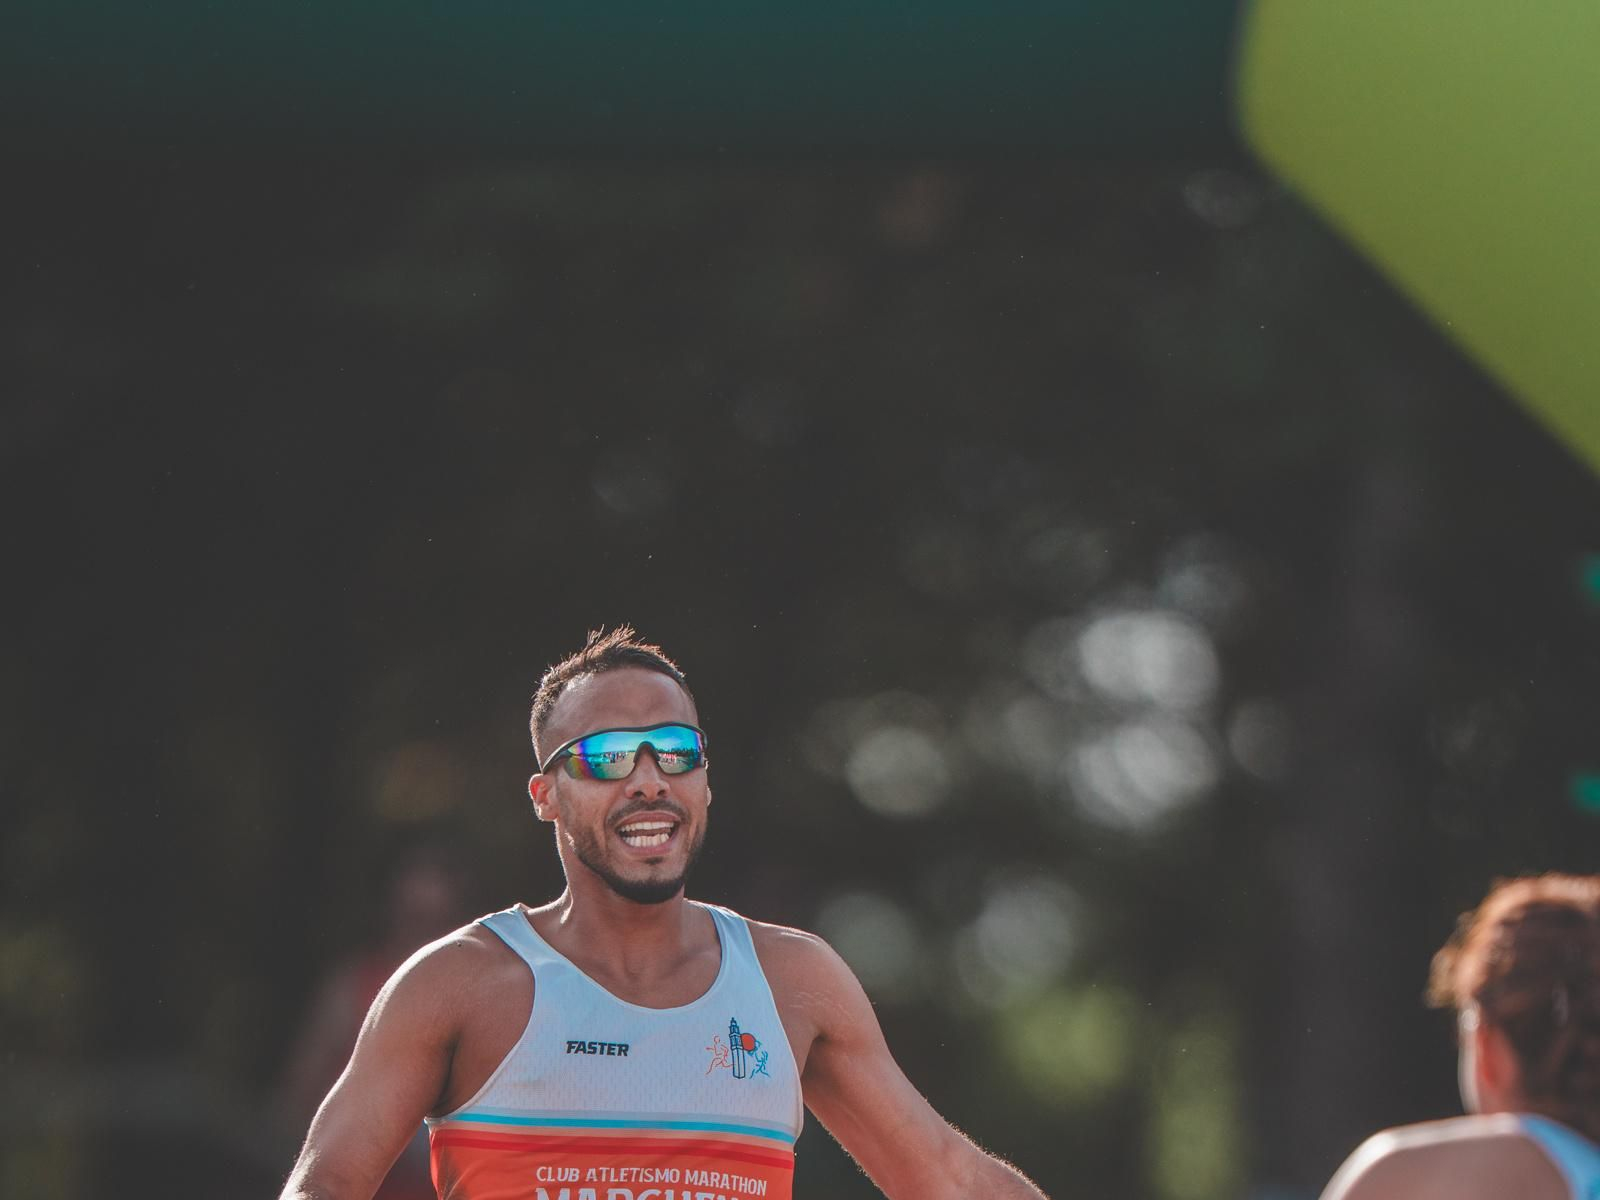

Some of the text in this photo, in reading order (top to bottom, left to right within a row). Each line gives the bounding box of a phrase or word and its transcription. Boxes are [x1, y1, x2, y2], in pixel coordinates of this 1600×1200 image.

[566, 1040, 629, 1056] FASTER
[536, 1166, 768, 1197] CLUB ATLETISMO MARATHON
